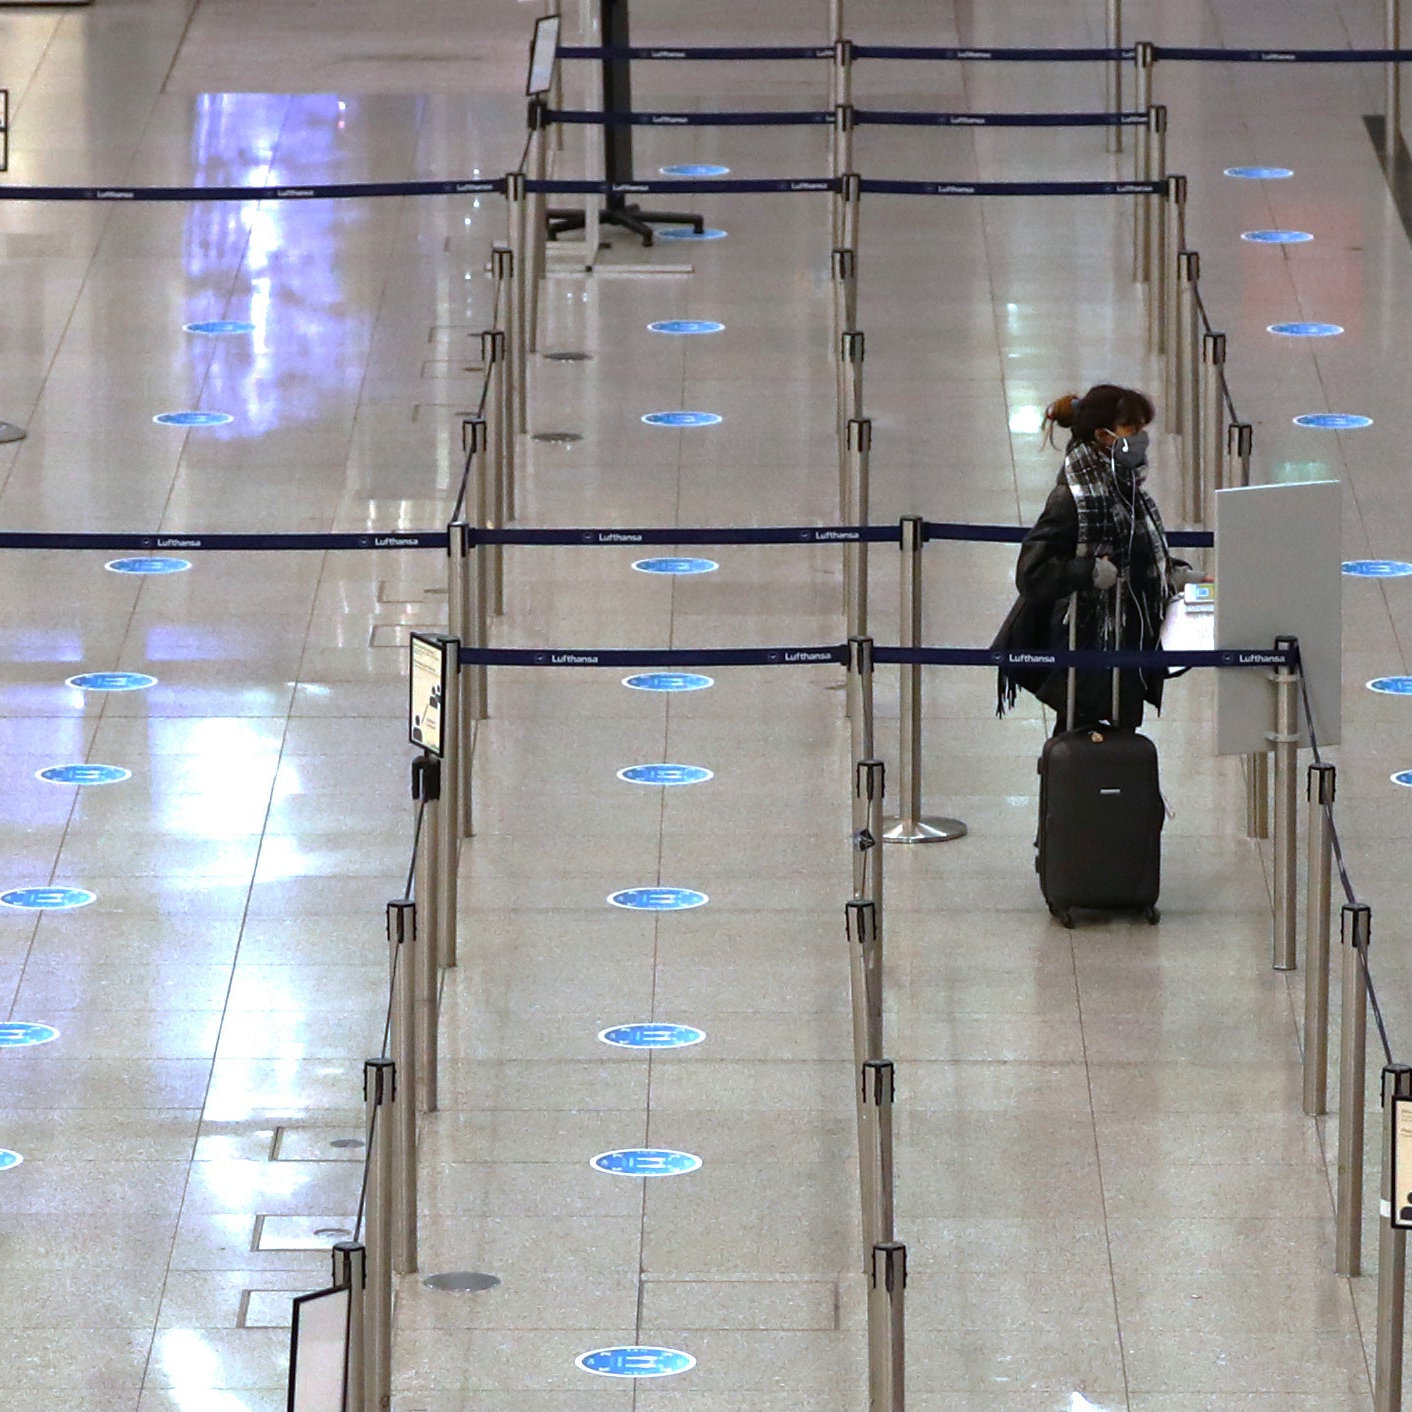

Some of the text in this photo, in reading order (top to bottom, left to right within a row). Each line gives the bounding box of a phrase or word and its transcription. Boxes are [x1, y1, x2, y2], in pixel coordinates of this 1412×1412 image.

[599, 532, 642, 542] Lufthansa
[815, 530, 859, 540] Lufthansa
[157, 537, 201, 547] Lufthansa
[375, 536, 419, 546] Lufthansa
[552, 654, 599, 664] Lufthansa
[785, 651, 832, 661] Lufthansa
[1009, 653, 1055, 663] Lufthansa
[1239, 653, 1285, 663] Lufthansa
